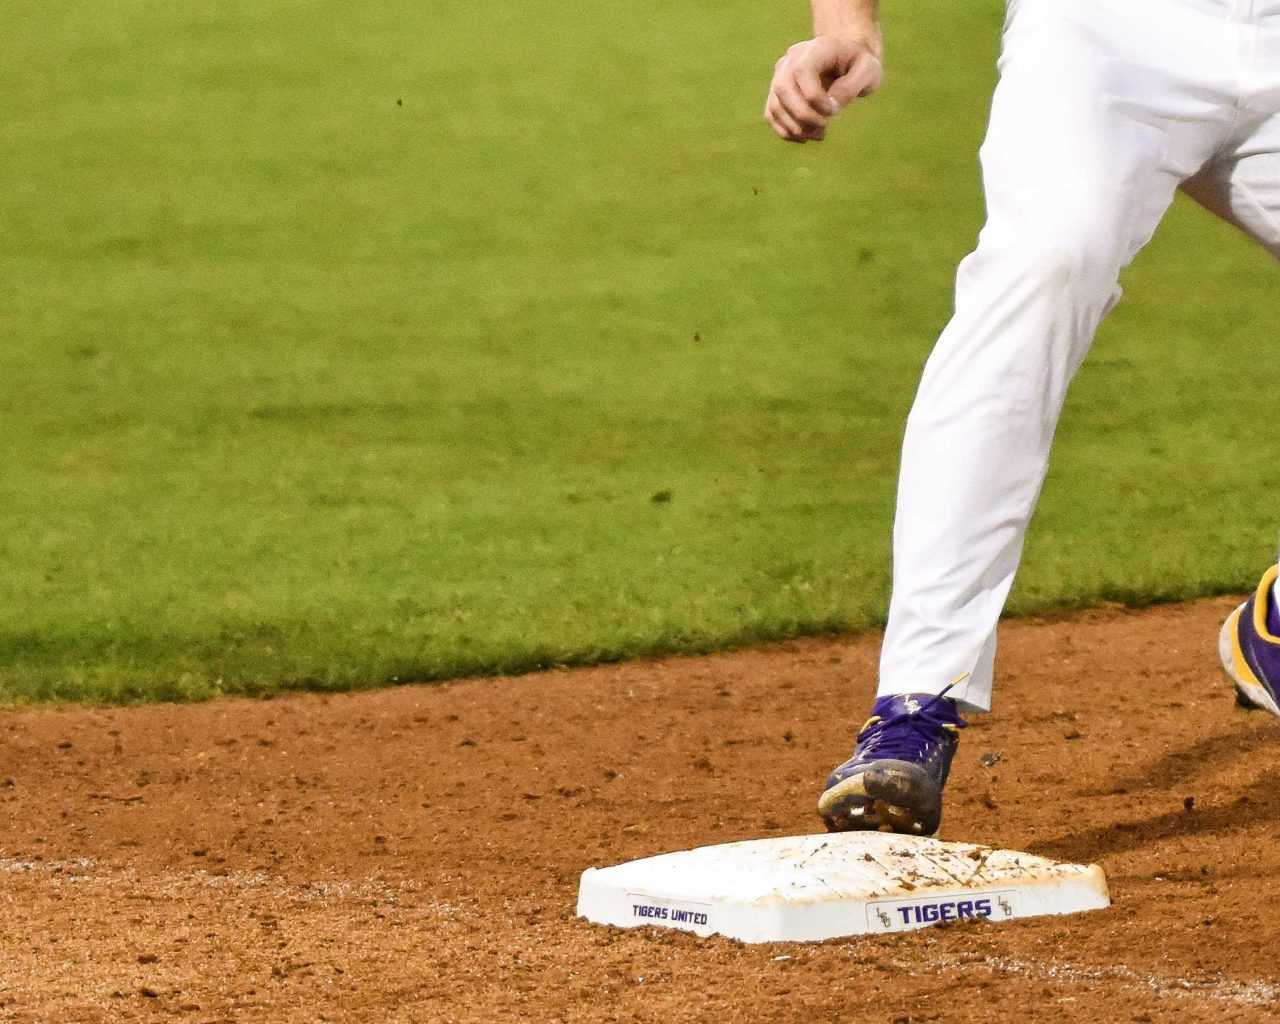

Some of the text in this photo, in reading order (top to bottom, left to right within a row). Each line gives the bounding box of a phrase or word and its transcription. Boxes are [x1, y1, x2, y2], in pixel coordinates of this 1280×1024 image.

[633, 904, 708, 925] TIGERS UNITED
[897, 899, 992, 924] TIGERS
